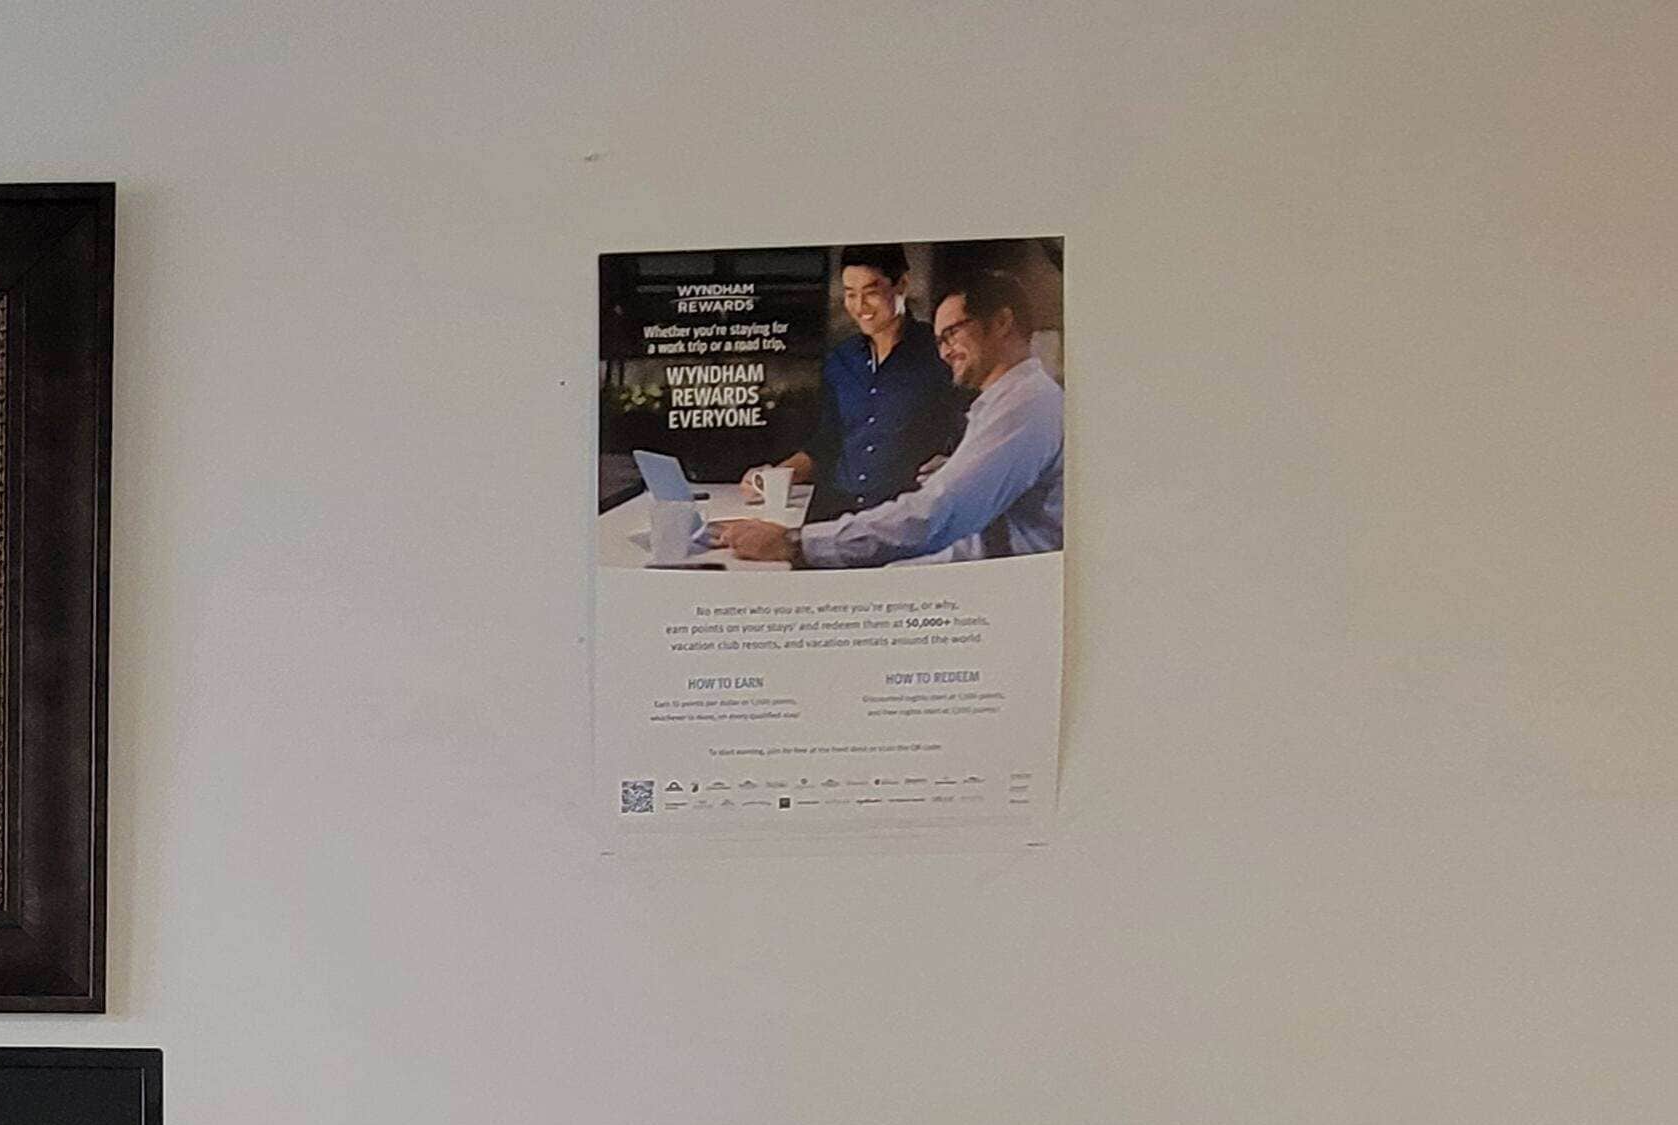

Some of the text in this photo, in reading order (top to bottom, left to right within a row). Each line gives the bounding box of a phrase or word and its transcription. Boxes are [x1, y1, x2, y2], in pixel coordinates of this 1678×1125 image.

[676, 283, 755, 297] WYNDHAM
[677, 299, 755, 313] REWARDS
[643, 320, 790, 339] Whether you're staying for
[647, 343, 656, 354] a
[657, 340, 686, 354] work
[687, 339, 708, 355] trip
[709, 341, 723, 352] or
[724, 341, 733, 352] a
[734, 337, 760, 351] road
[666, 363, 765, 386] WYNDHAM
[671, 385, 760, 408] REWARDS
[668, 407, 768, 429] EVERYONE.
[905, 617, 951, 629] 50,000+
[687, 677, 764, 690] HOW TO EARN
[885, 673, 913, 685] HOW
[917, 672, 931, 684] TO
